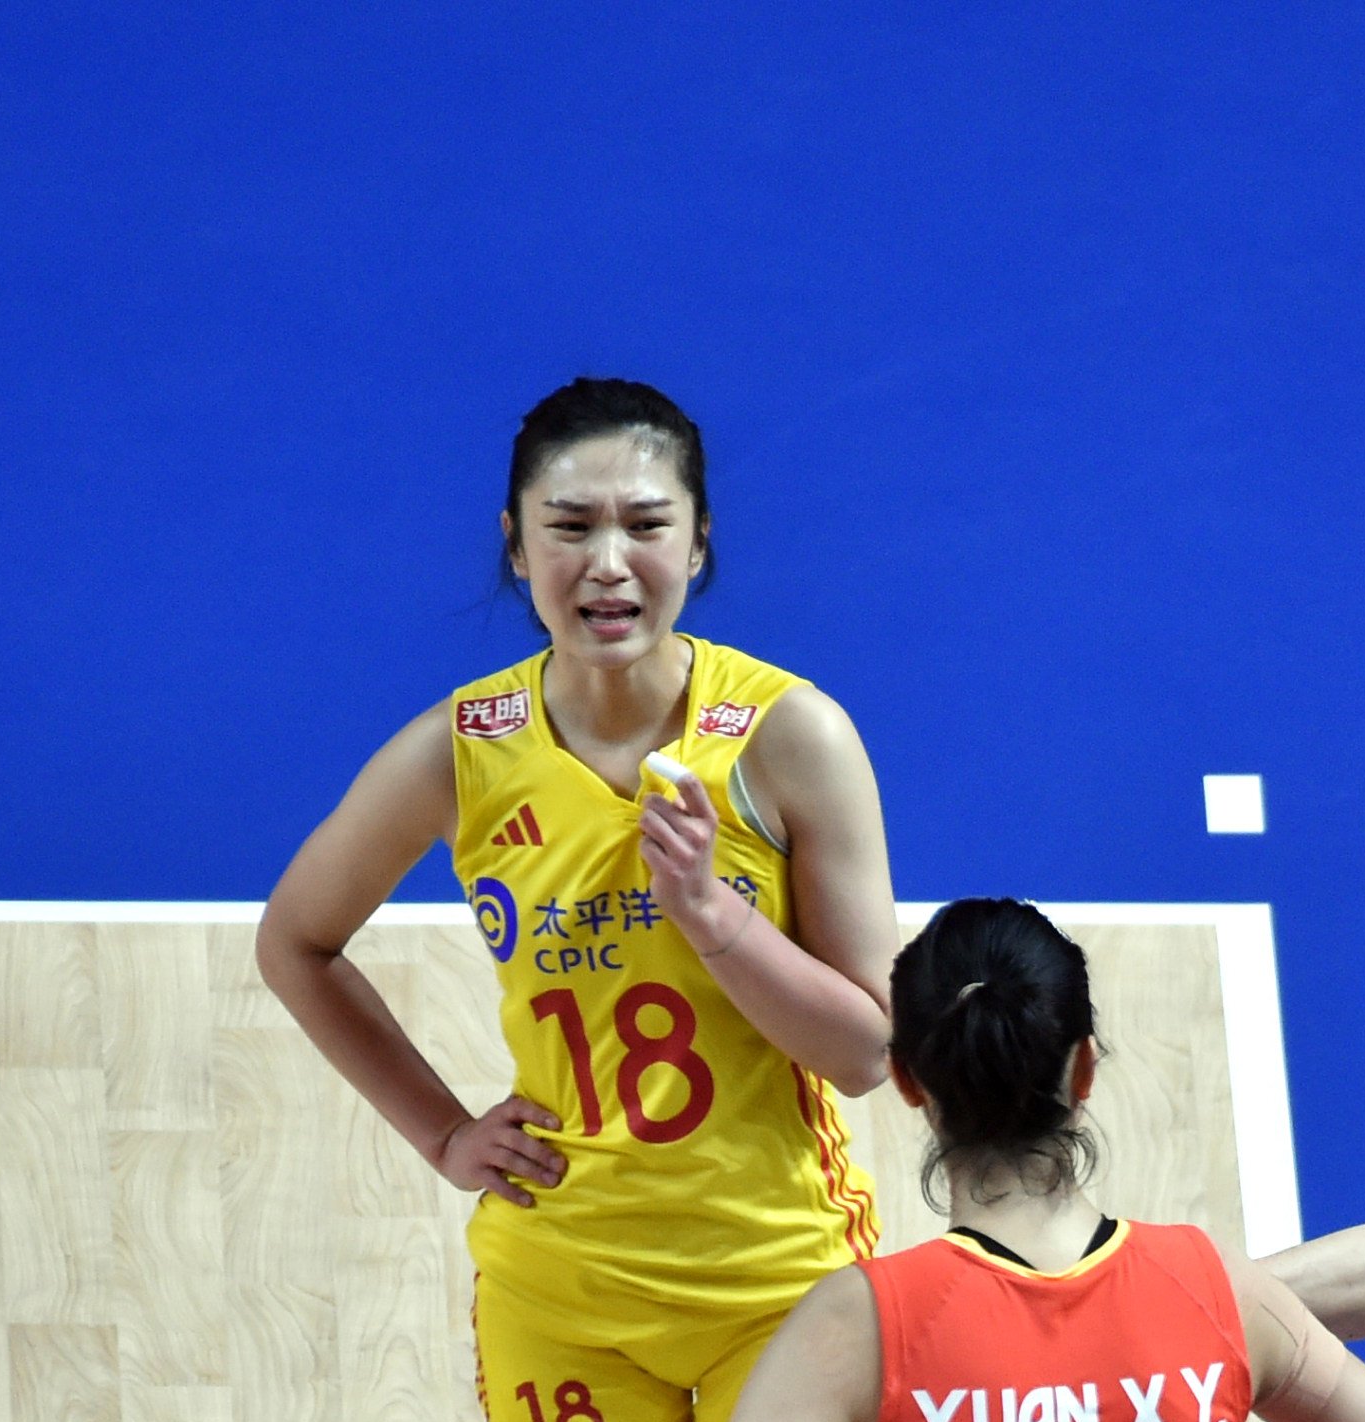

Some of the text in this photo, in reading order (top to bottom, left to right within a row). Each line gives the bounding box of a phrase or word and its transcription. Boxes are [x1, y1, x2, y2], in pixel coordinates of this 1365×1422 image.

[460, 691, 527, 725] 光明
[534, 943, 624, 974] CPIC
[530, 981, 715, 1144] 18
